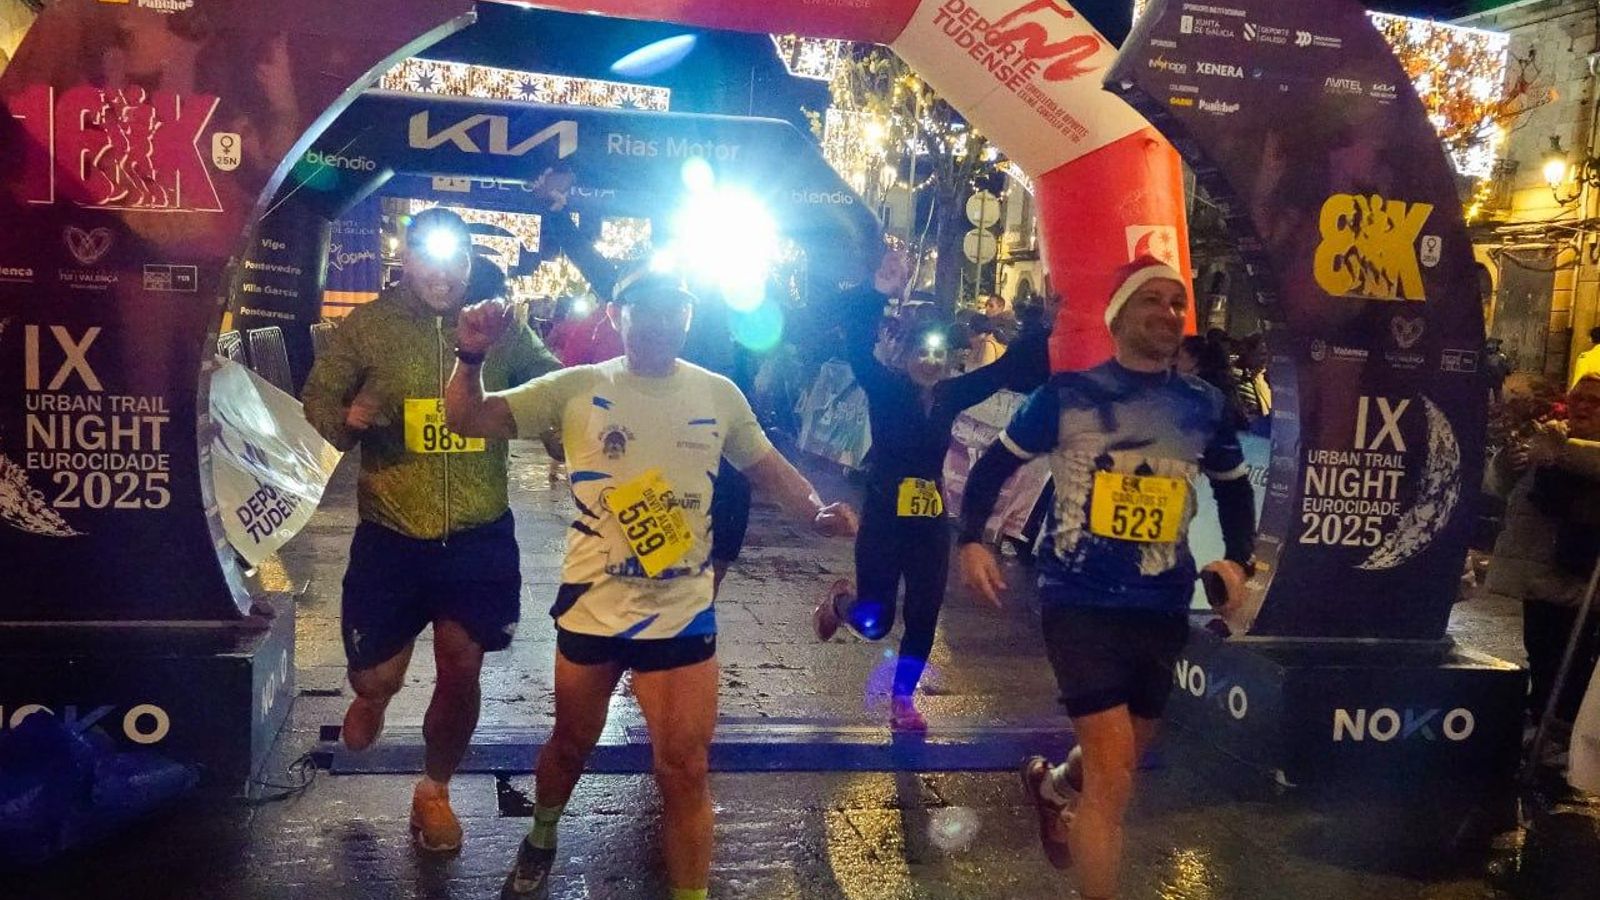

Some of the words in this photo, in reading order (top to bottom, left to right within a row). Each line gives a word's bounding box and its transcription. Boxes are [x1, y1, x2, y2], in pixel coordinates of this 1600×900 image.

[932, 7, 1022, 92] TUDENSE
[943, 0, 1041, 80] DEPORTE
[1196, 62, 1244, 79] XENERA
[1324, 77, 1362, 92] AVATEL
[409, 110, 578, 160] KIA
[306, 149, 376, 171] blendio
[666, 136, 740, 161] Motor
[216, 156, 238, 166] 25N
[791, 189, 853, 205] blendio
[262, 239, 286, 250] Vigo
[245, 261, 302, 276] Pontevedra
[243, 283, 262, 293] Villa
[25, 325, 105, 391] IX
[26, 394, 102, 412] URBAN
[108, 396, 170, 413] TRAIL
[26, 414, 170, 451] NIGHT
[1355, 396, 1411, 452] IX
[27, 453, 170, 472] EUROCIDADE
[1308, 450, 1360, 466] URBAN
[1365, 453, 1406, 469] TRAIL
[52, 472, 171, 510] 2025
[1305, 466, 1406, 500] NIGHT
[910, 496, 938, 516] 570
[1303, 498, 1401, 516] EUROCIDADE
[618, 500, 666, 556] 559
[1111, 505, 1164, 539] 523
[1299, 513, 1383, 547] 2025
[1333, 707, 1475, 742] NOKO
